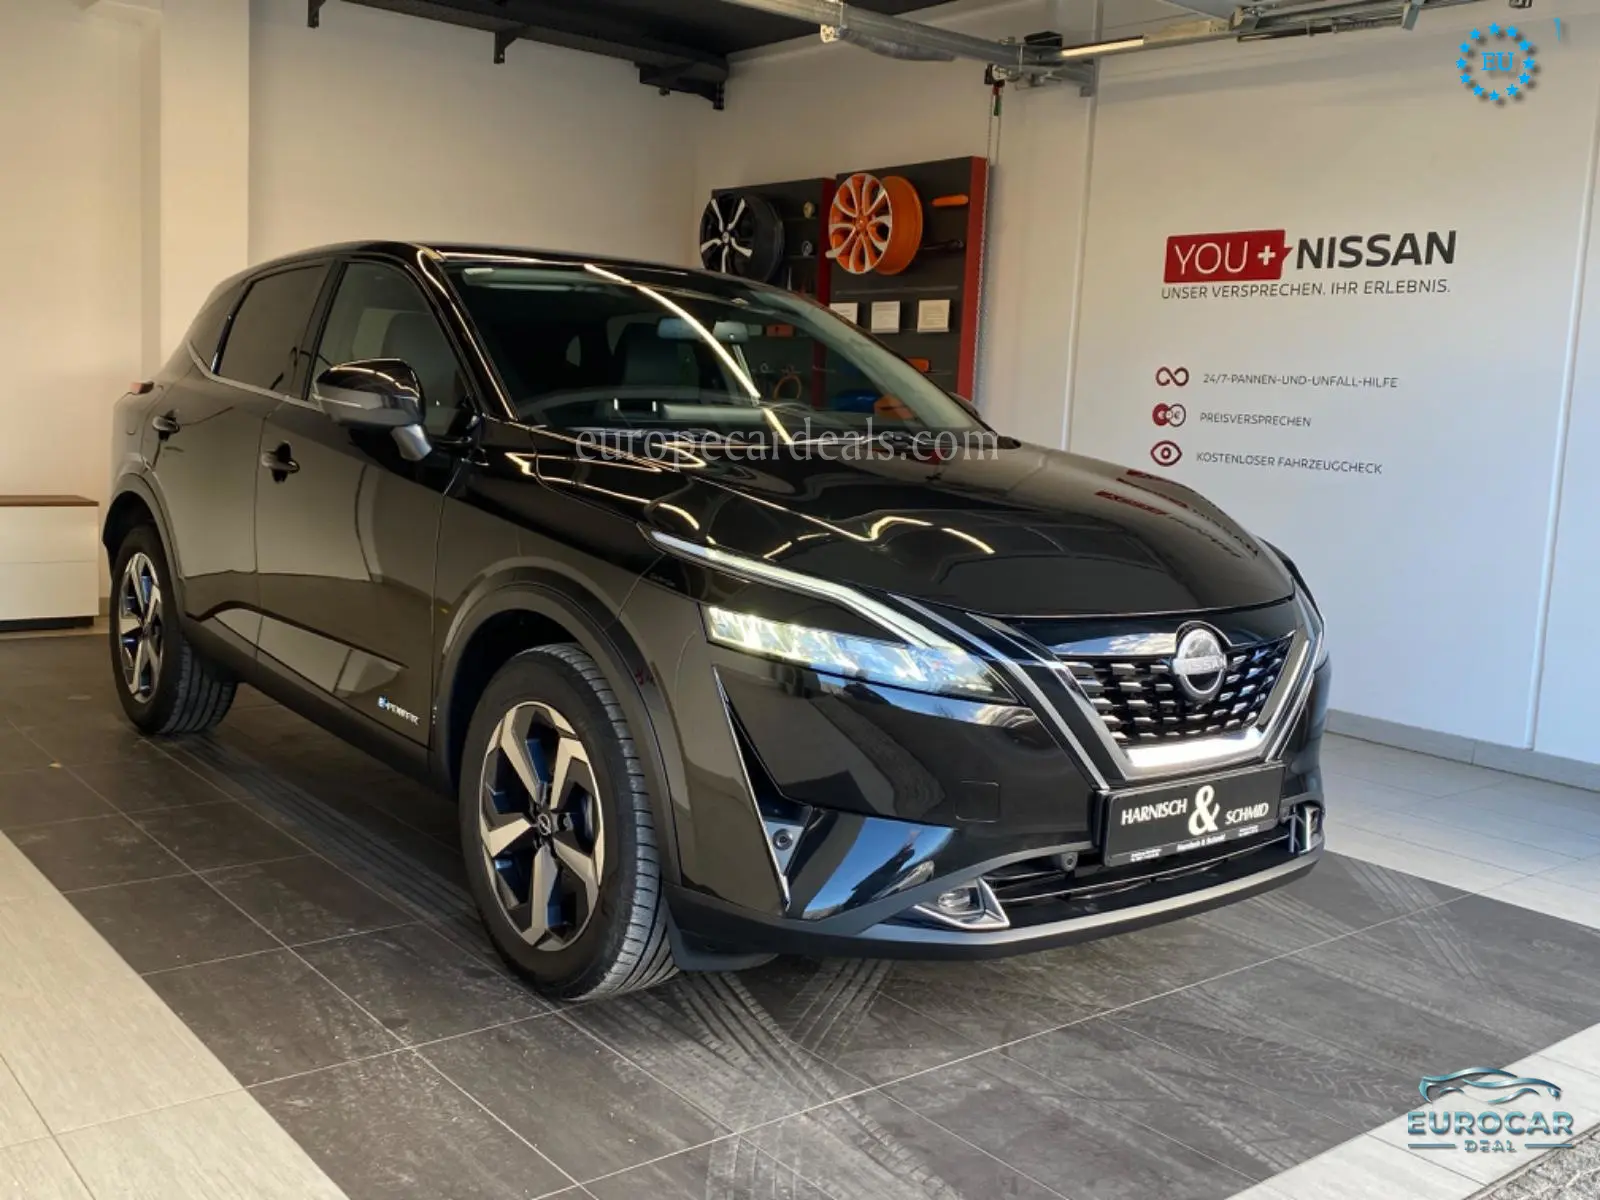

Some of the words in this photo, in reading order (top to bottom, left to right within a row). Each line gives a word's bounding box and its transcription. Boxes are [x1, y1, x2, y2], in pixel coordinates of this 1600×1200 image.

[1296, 230, 1456, 270] NISSAN
[1161, 286, 1208, 300] UNSER
[1212, 282, 1326, 298] VERSPRECHEN.
[1331, 281, 1358, 296] IHR
[1364, 278, 1450, 295] ERLEBNIS.
[1200, 412, 1312, 427] PREISVERSPRECHEN
[1196, 452, 1275, 467] KOSTENLOSER
[1277, 456, 1383, 475] FAHRZEUGCHECK
[1121, 799, 1187, 825] HARNISCH
[1188, 785, 1220, 836] &
[1225, 803, 1268, 824] SCHMID
